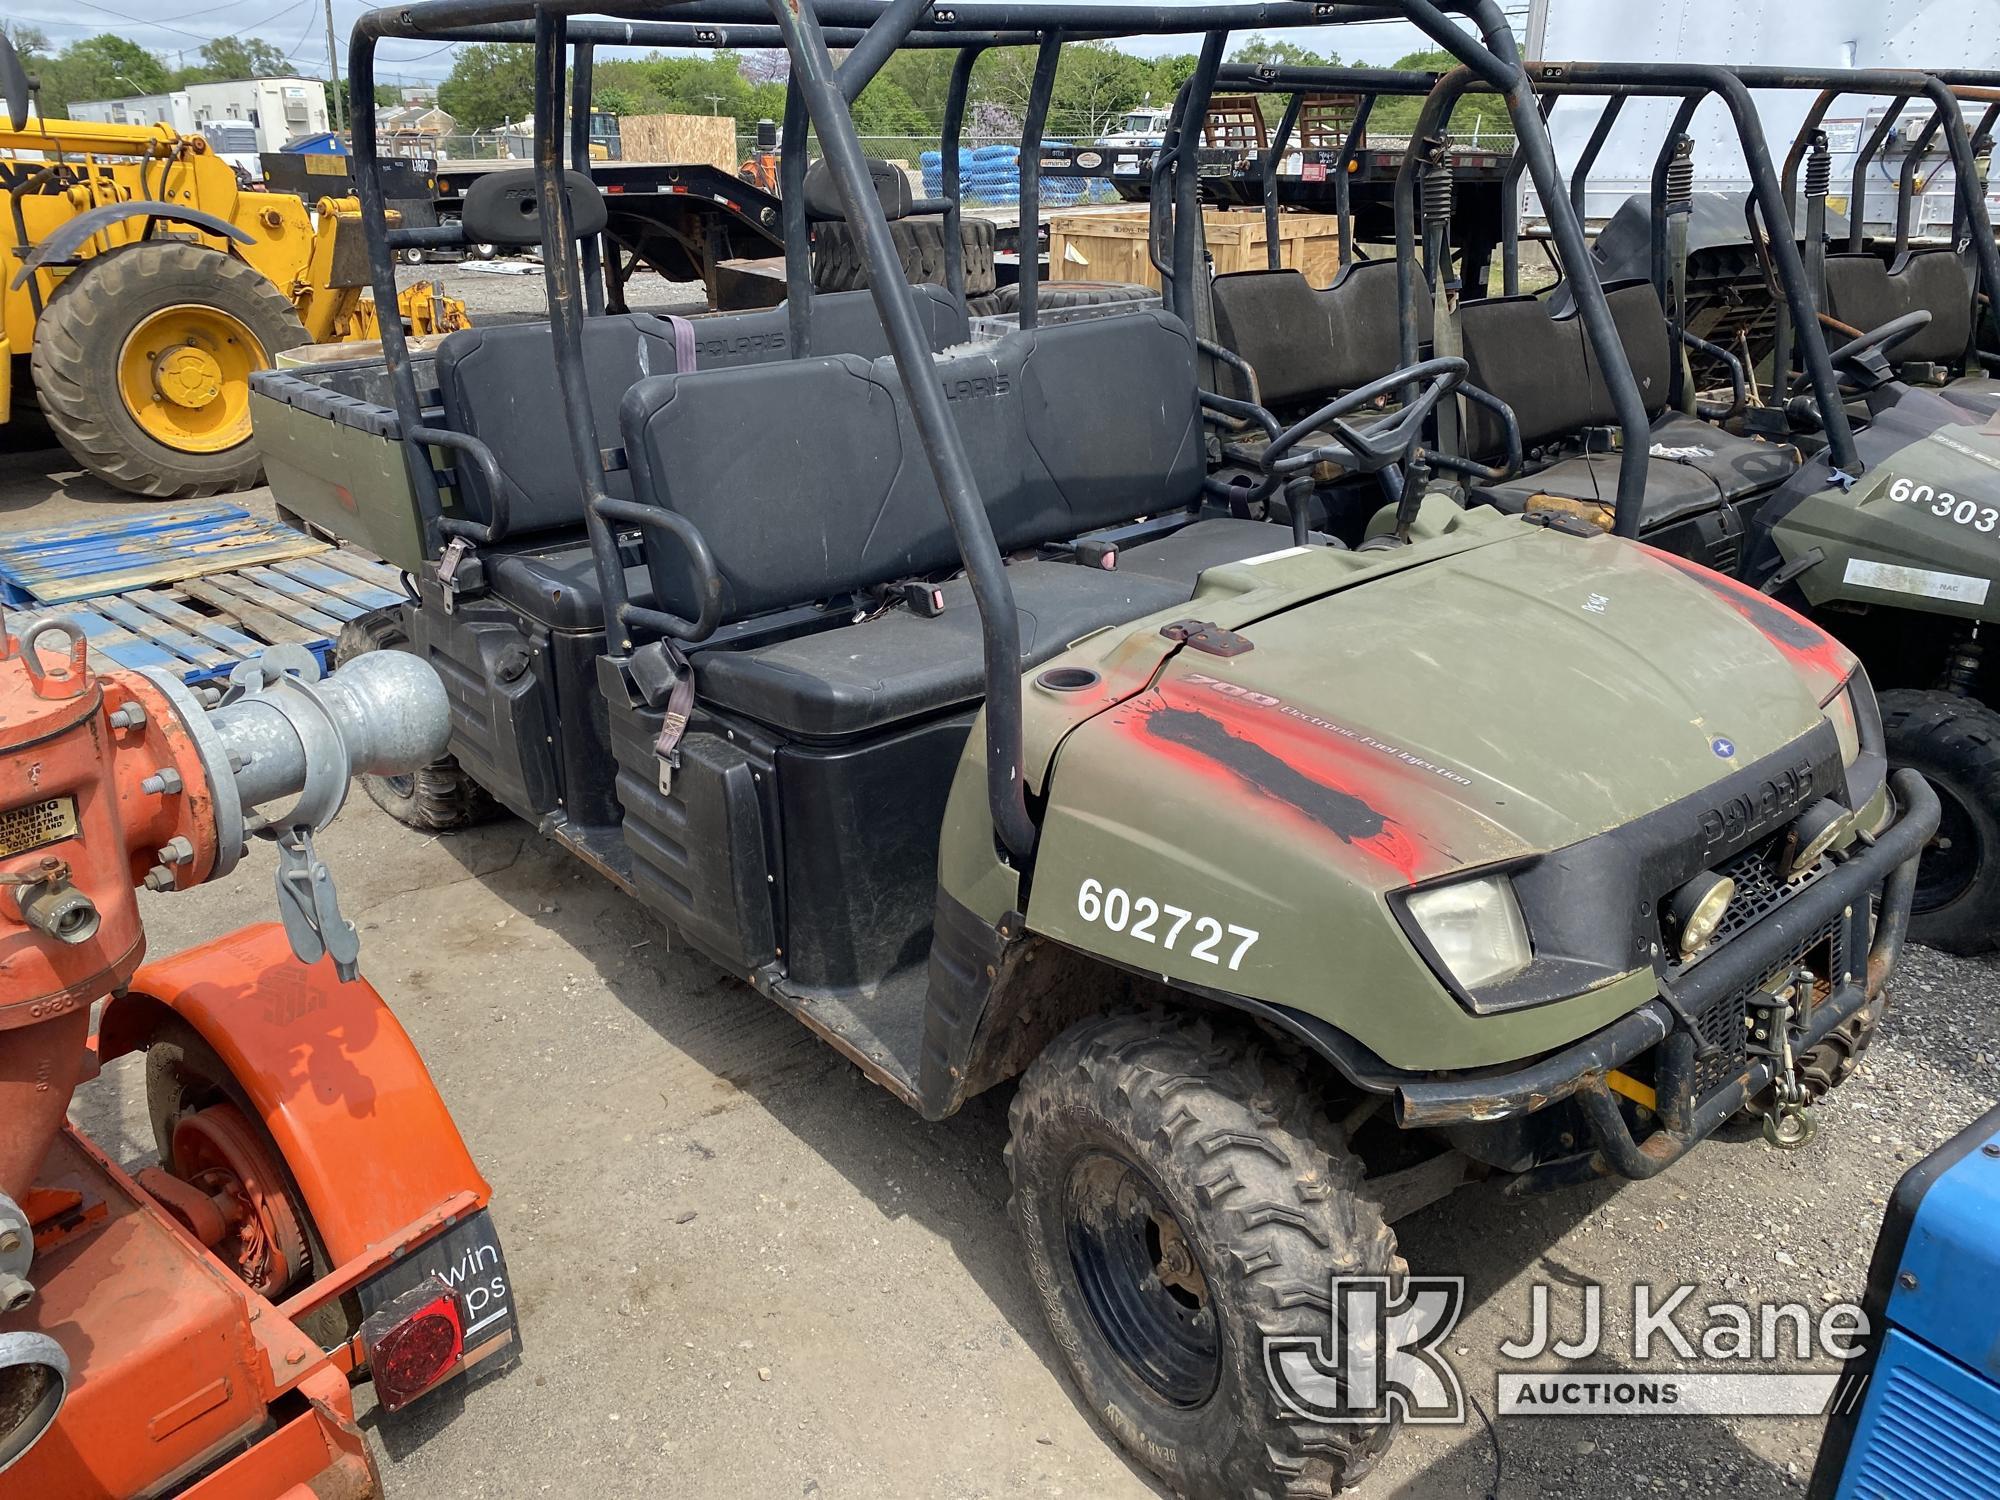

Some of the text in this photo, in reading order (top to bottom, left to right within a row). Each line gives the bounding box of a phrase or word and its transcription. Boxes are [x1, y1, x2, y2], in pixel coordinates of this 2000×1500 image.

[942, 374, 1010, 402] LARIS
[1183, 673, 1472, 786] 700 Electronic Fuel Injection
[17, 815, 41, 827] PUMP
[44, 811, 53, 819] IN
[1697, 758, 1812, 855] POLARIS
[15, 828, 42, 840] VALVE
[46, 821, 62, 831] AND
[23, 814, 65, 831] WEATHER
[7, 834, 41, 849] VOLUTE
[1078, 878, 1260, 971] 602727
[431, 1244, 498, 1288] win
